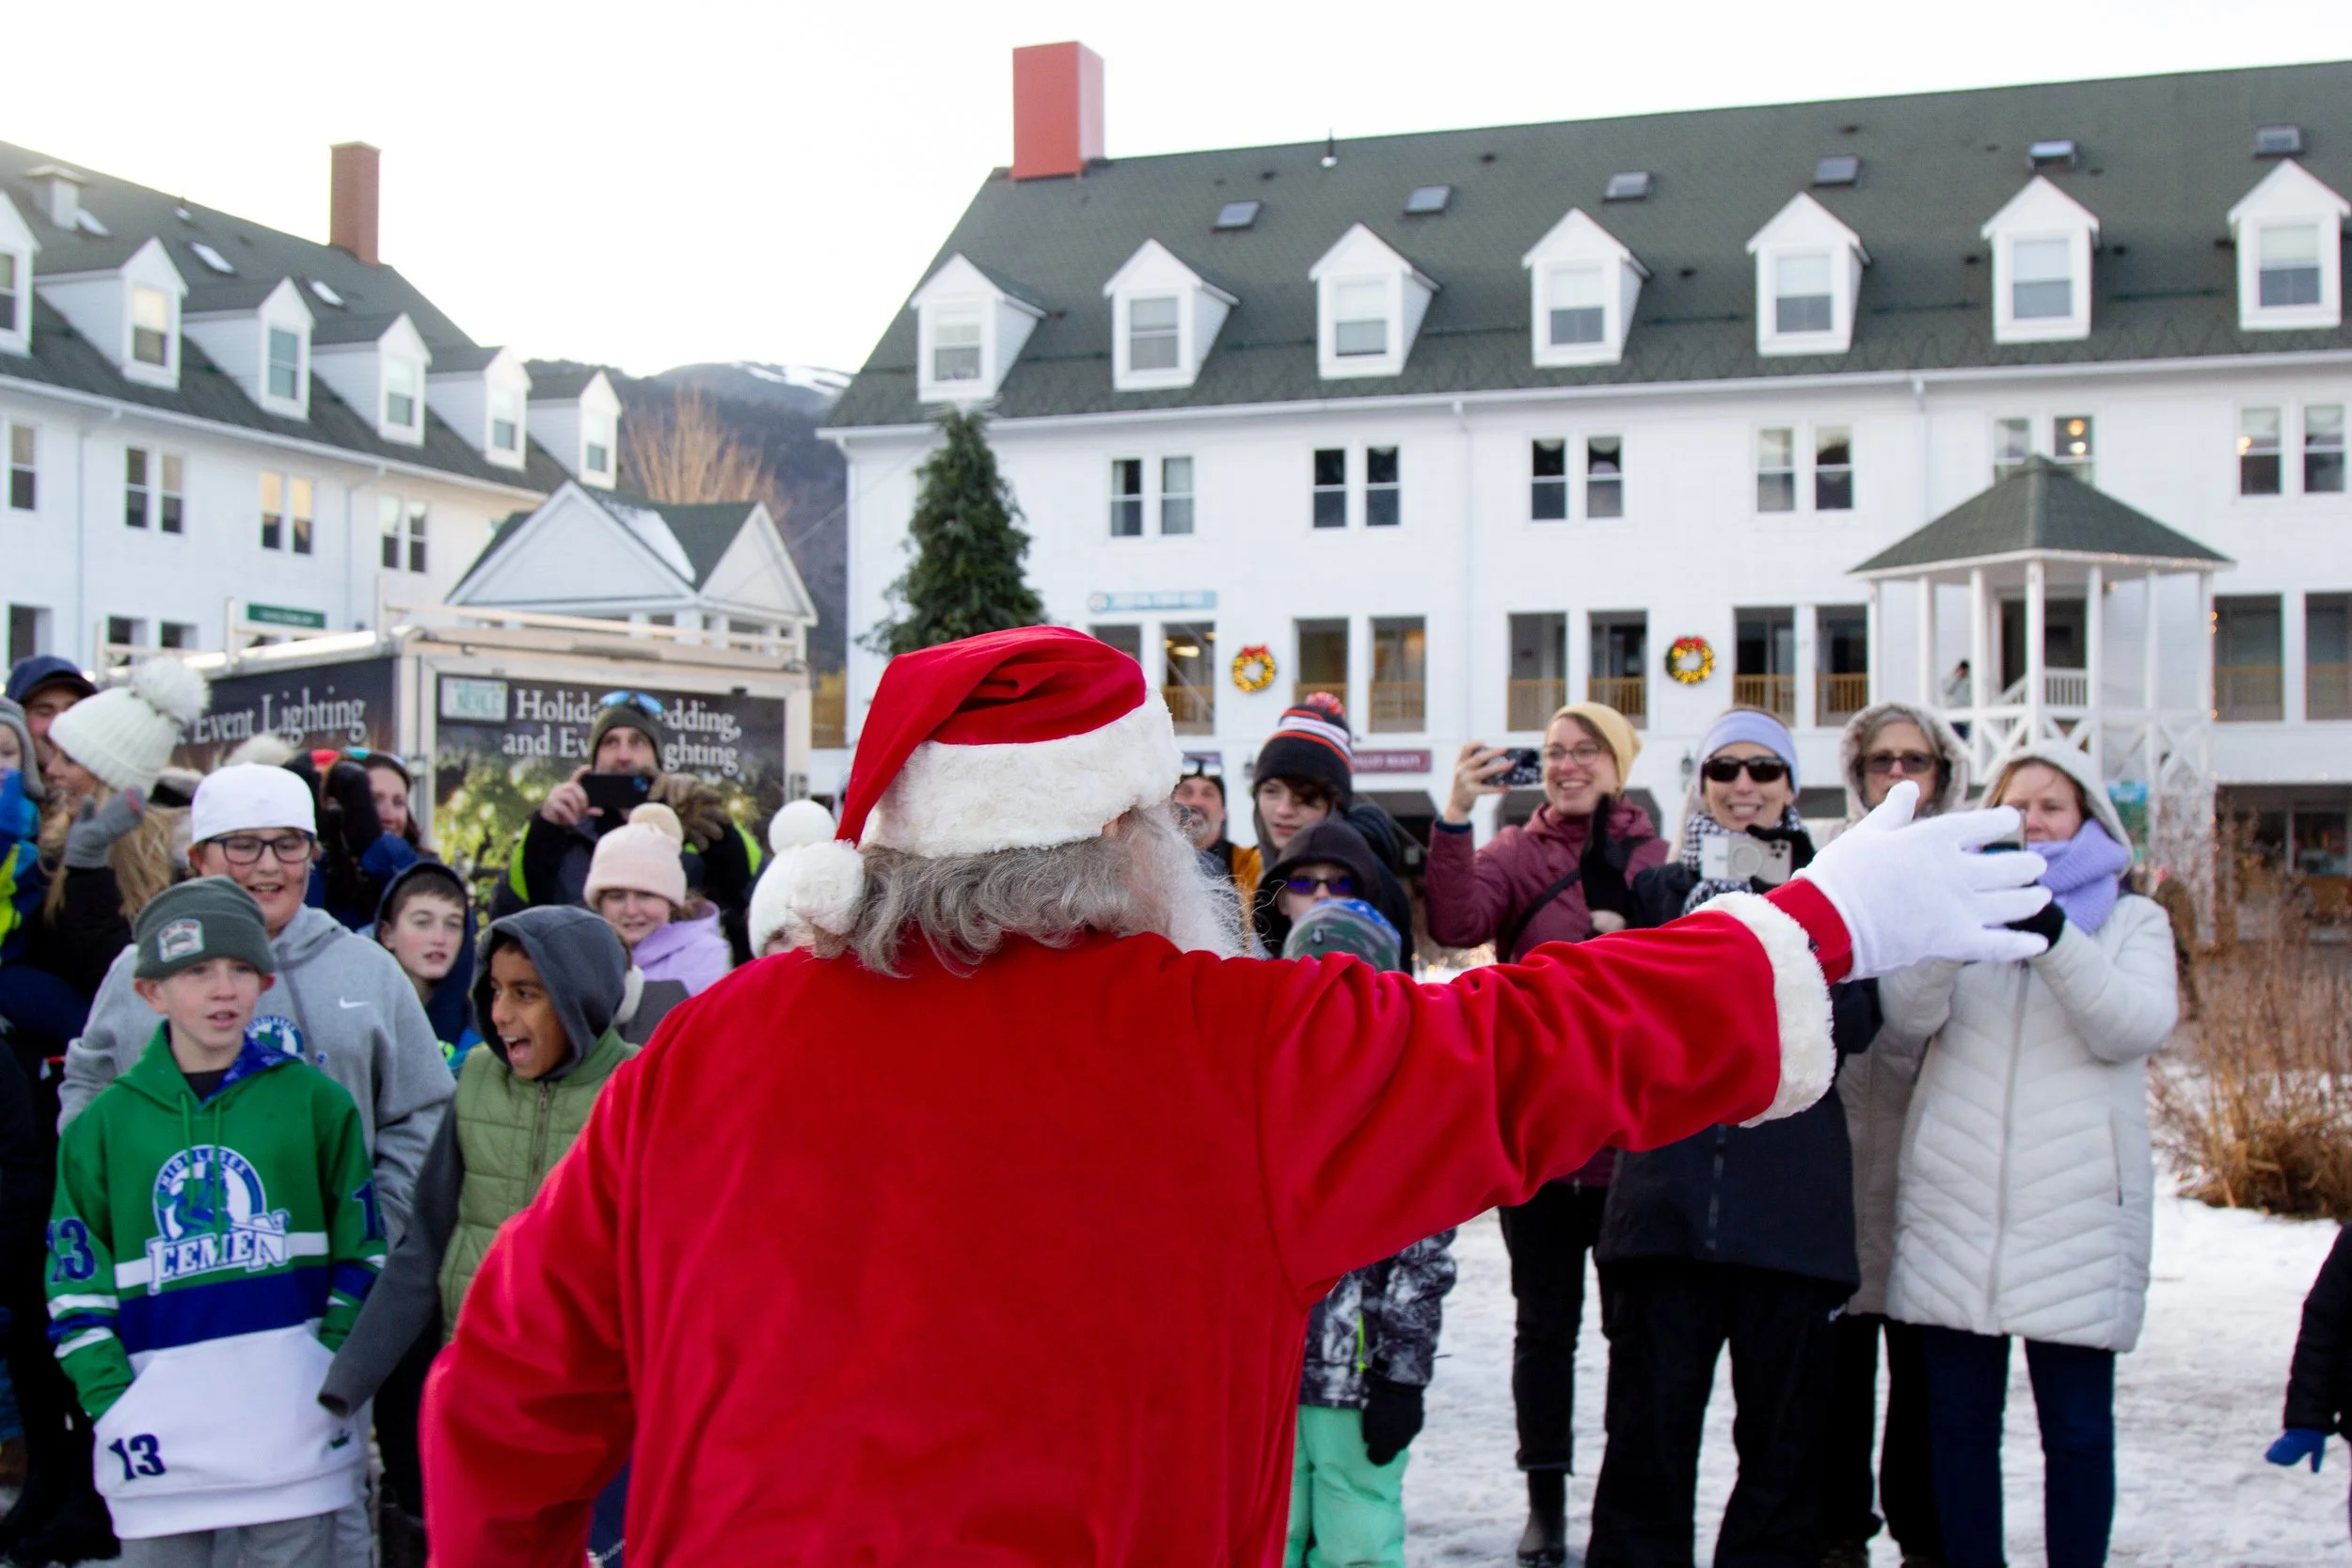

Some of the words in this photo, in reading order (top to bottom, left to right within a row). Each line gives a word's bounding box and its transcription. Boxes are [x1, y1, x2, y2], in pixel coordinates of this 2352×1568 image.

[193, 707, 255, 744] Event
[261, 685, 367, 749] Lighting
[515, 689, 601, 723] Holida
[501, 723, 551, 756] and
[662, 733, 739, 777] ghting
[146, 1208, 290, 1295] ICEMEN
[108, 1433, 167, 1481] 13
